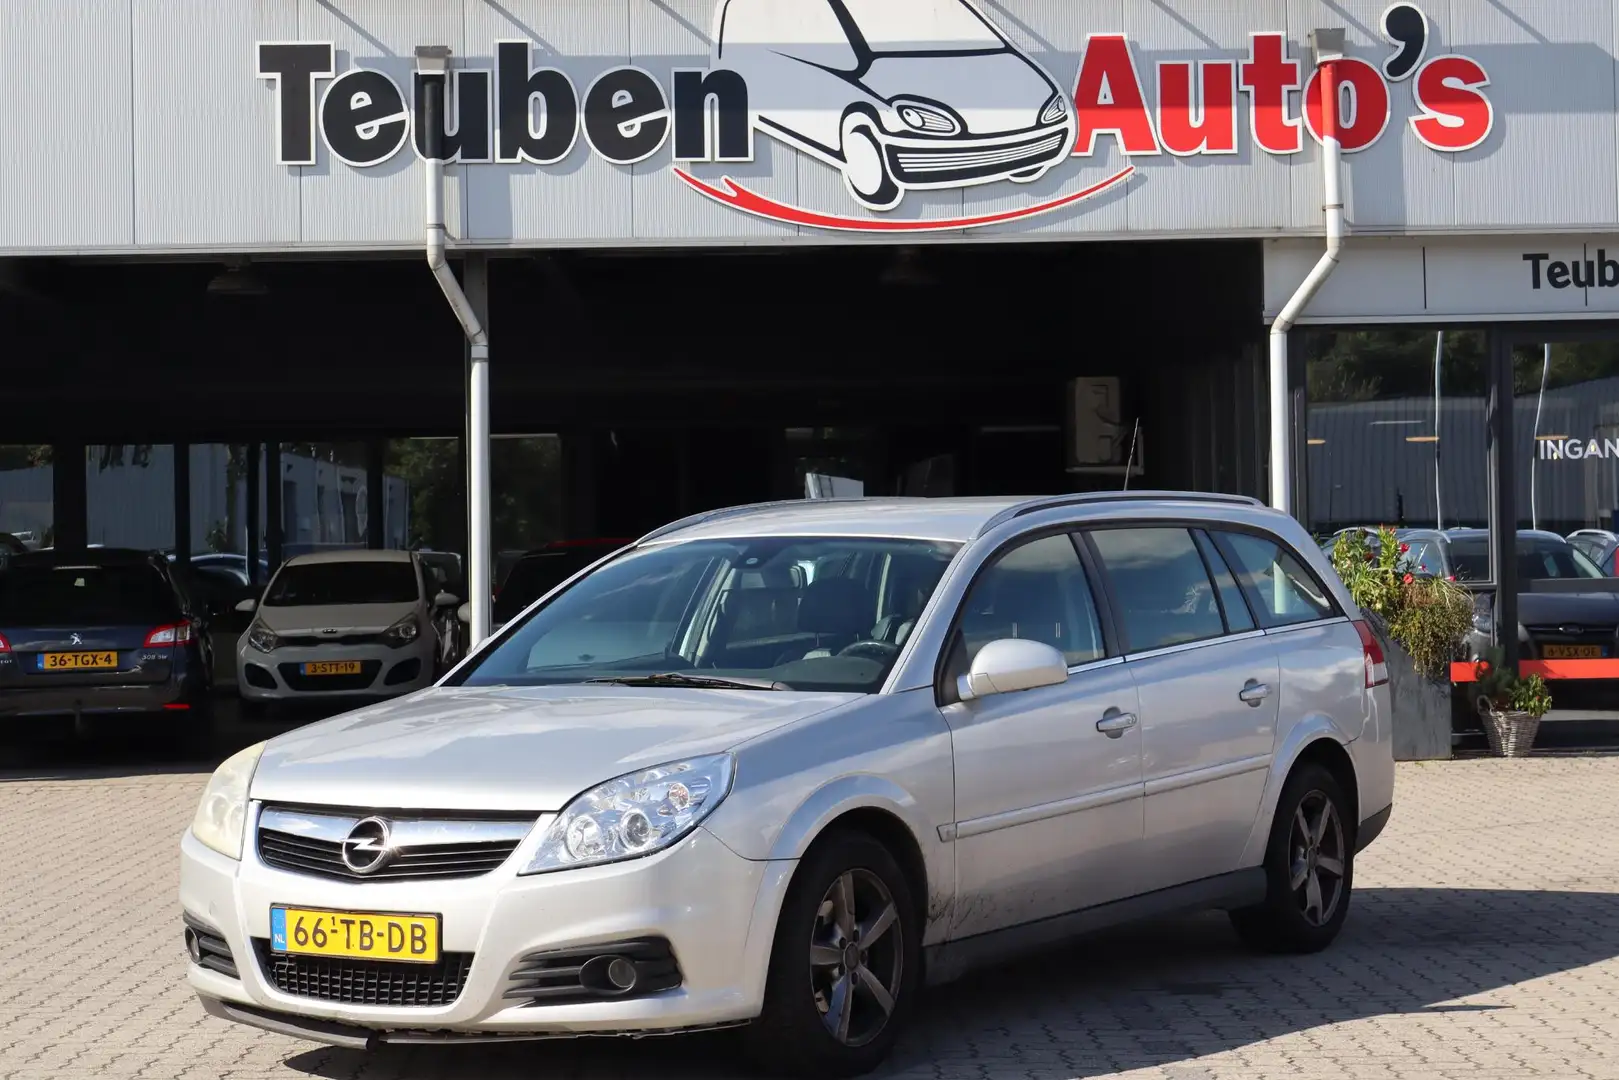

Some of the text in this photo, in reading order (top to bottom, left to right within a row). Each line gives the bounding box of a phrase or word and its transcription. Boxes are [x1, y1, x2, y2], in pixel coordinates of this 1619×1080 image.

[256, 3, 1494, 166] Teuben Auto's
[1522, 248, 1619, 290] Teub
[1539, 438, 1619, 460] INGAN
[49, 652, 112, 667] 36-TGX-4
[310, 662, 355, 673] 3-STT-19
[274, 916, 427, 955] NL 66-TB-DB
